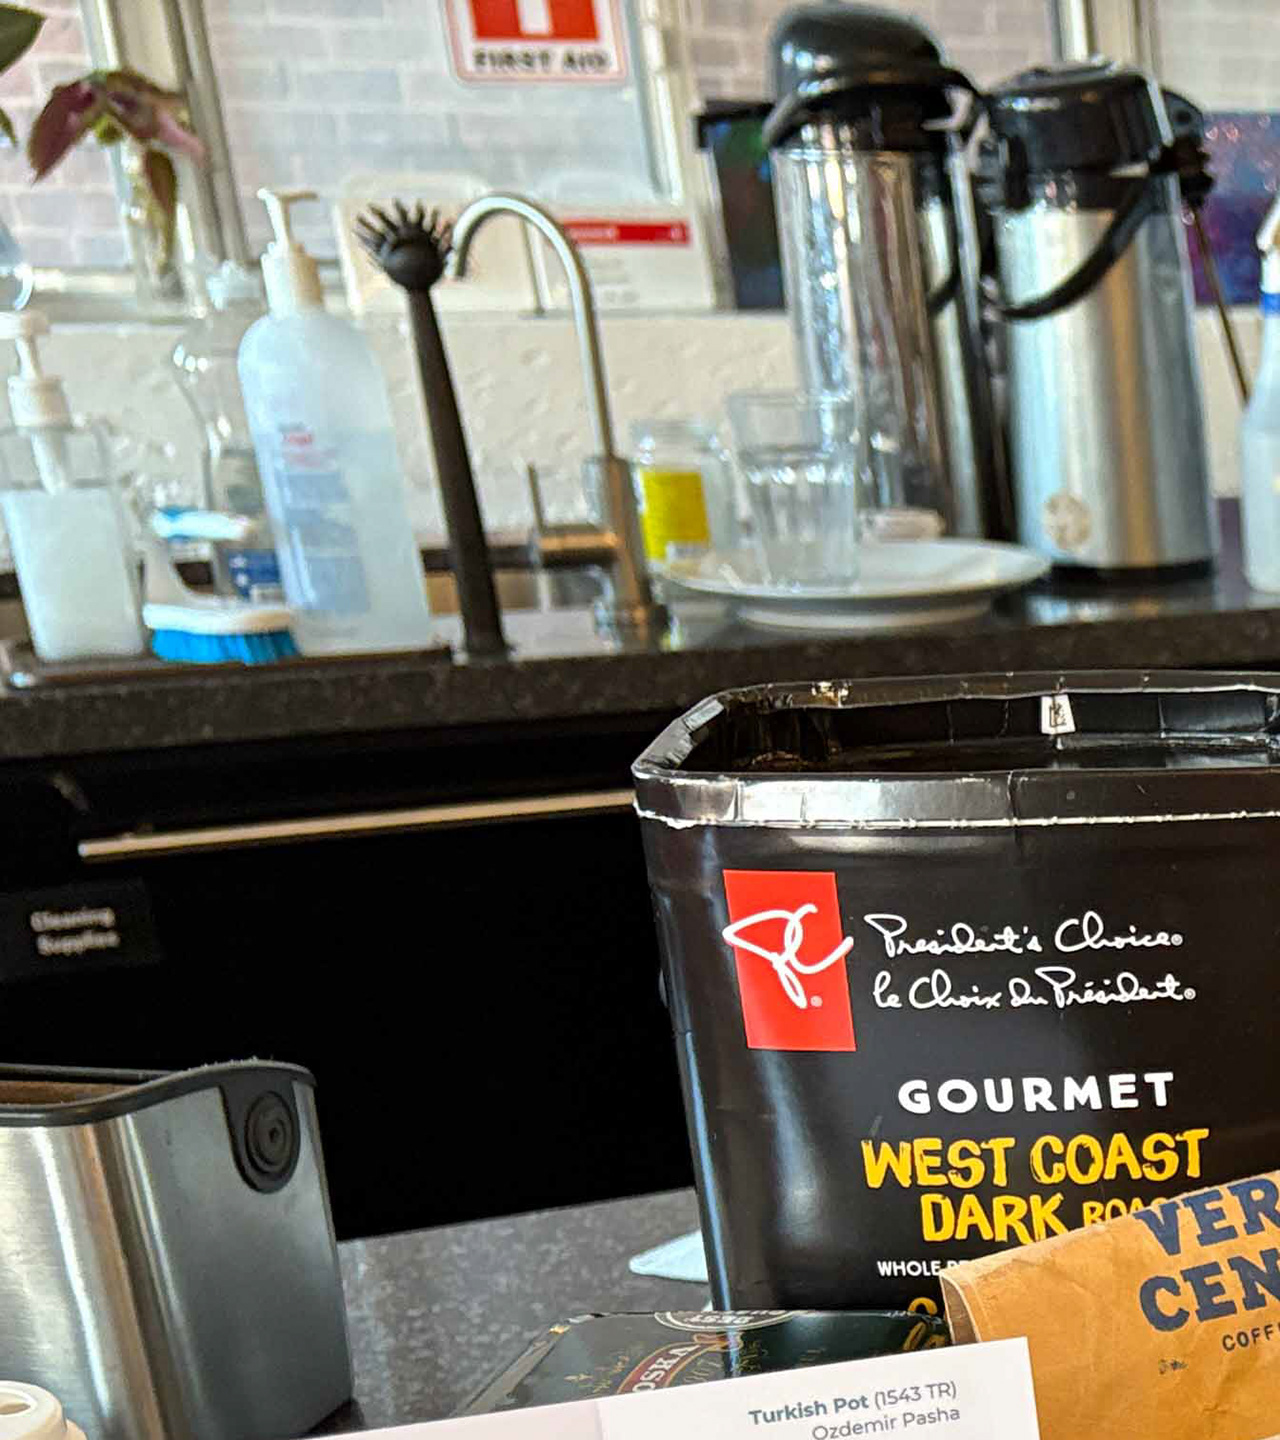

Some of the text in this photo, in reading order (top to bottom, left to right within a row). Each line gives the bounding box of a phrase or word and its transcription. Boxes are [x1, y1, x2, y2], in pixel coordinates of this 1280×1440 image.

[473, 48, 608, 72] FIRST AID
[864, 912, 1043, 958] President's
[909, 969, 1002, 1009] Choix
[898, 1072, 1174, 1116] GOURMET
[860, 1128, 1210, 1189] WEST COAST
[920, 1191, 1070, 1246] DARK
[877, 1260, 941, 1277] WHOLE
[747, 1381, 957, 1426] Turkish Pot (1543 TR)
[812, 1407, 961, 1440] Ozdemir Pasha
